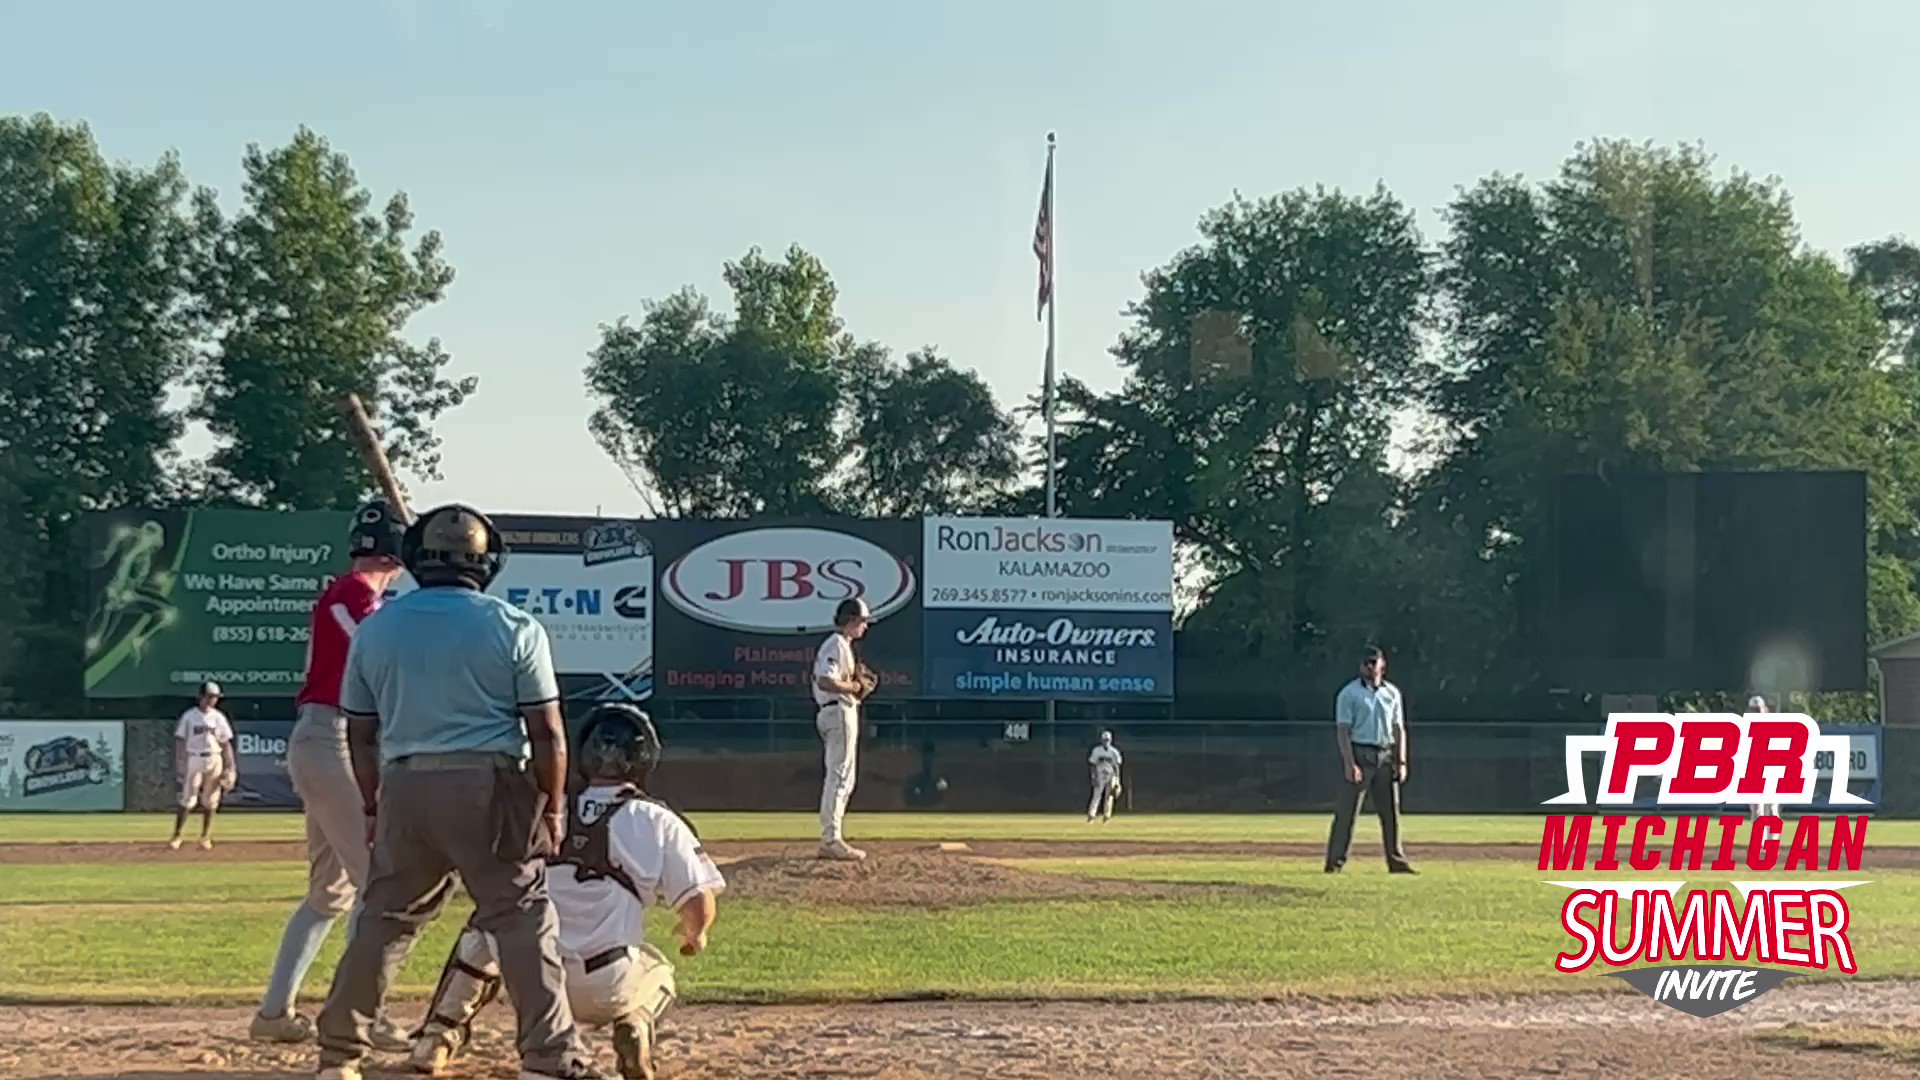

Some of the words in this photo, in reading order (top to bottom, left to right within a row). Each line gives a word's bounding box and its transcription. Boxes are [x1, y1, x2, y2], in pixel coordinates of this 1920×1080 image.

[938, 525, 1101, 553] RonJackson
[211, 543, 266, 560] Ortho
[269, 543, 332, 565] Injury?
[704, 558, 866, 601] JBS
[999, 561, 1111, 578] KALAMAZOO
[184, 575, 216, 590] We
[219, 574, 266, 590] Have
[269, 574, 318, 590] Same
[206, 595, 319, 615] Appointmen
[212, 625, 254, 642] (855)
[256, 626, 309, 641] 618-26
[956, 616, 1156, 647] Auto-Owners
[996, 649, 1116, 665] INSURANCE
[667, 670, 745, 689] Bringing
[751, 670, 796, 685] More
[956, 671, 1022, 693] simple
[1027, 672, 1093, 690] human
[1098, 675, 1155, 690] sense
[238, 733, 286, 754] Blue
